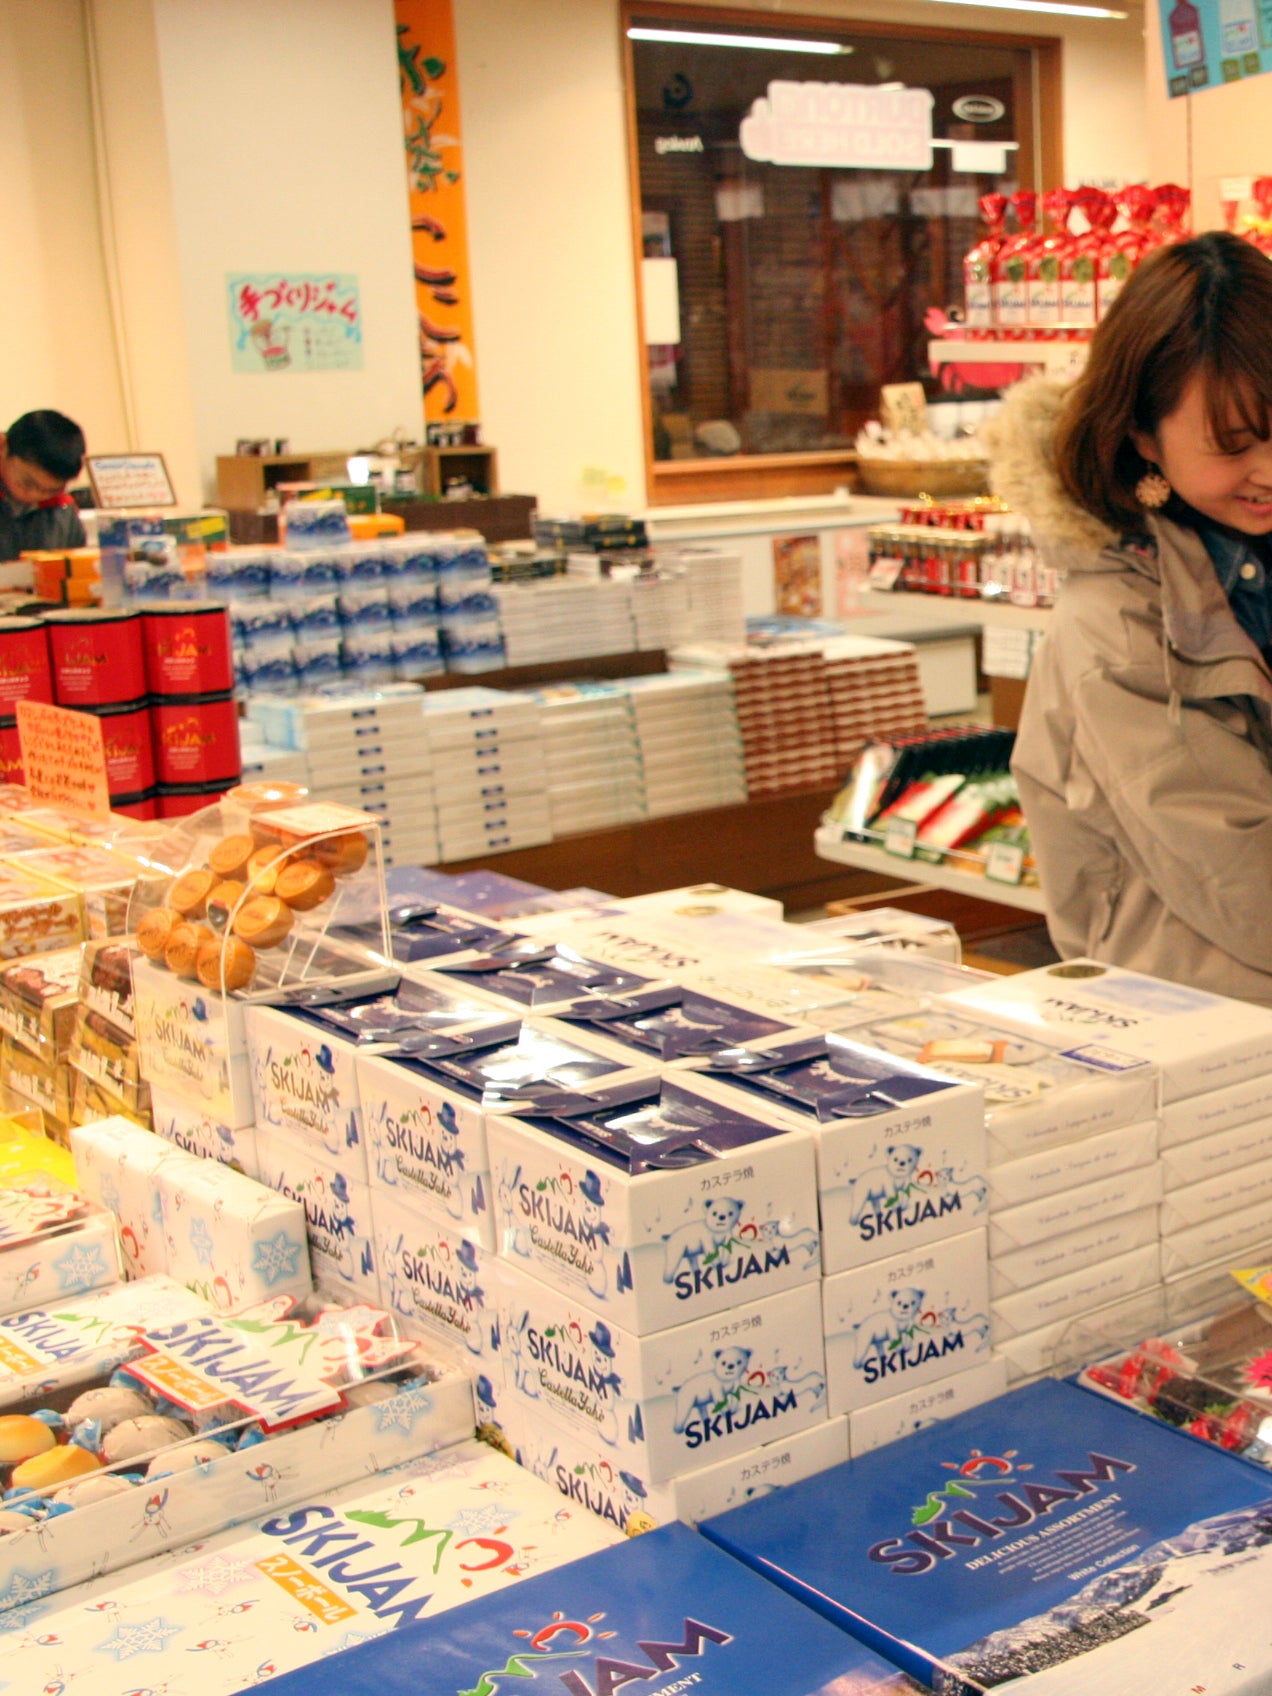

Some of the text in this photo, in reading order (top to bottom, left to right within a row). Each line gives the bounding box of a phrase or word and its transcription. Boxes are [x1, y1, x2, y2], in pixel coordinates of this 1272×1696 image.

[271, 1061, 331, 1115] SKIJAM
[386, 1117, 454, 1178] SKIJAM
[701, 1166, 755, 1191] カステラ焼
[520, 1184, 597, 1252] SKIJAM
[859, 1190, 961, 1241] SKIJAM
[402, 1250, 473, 1313] SKIJAM
[675, 1244, 791, 1300] SKIJAM
[709, 1315, 763, 1343] カステラ焼
[863, 1330, 965, 1384] SKIJAM
[146, 1317, 323, 1418] SKIJAM
[528, 1328, 608, 1400] SKIJAM
[685, 1388, 798, 1448] SKIJAM
[740, 1452, 792, 1481] カステラ焼
[868, 1452, 1137, 1575] SKIJAM
[965, 1534, 1041, 1571] DELICIOUS
[1038, 1492, 1123, 1539] ASSORTMENT
[259, 1555, 350, 1621] スノーボール
[1067, 1564, 1098, 1581] White
